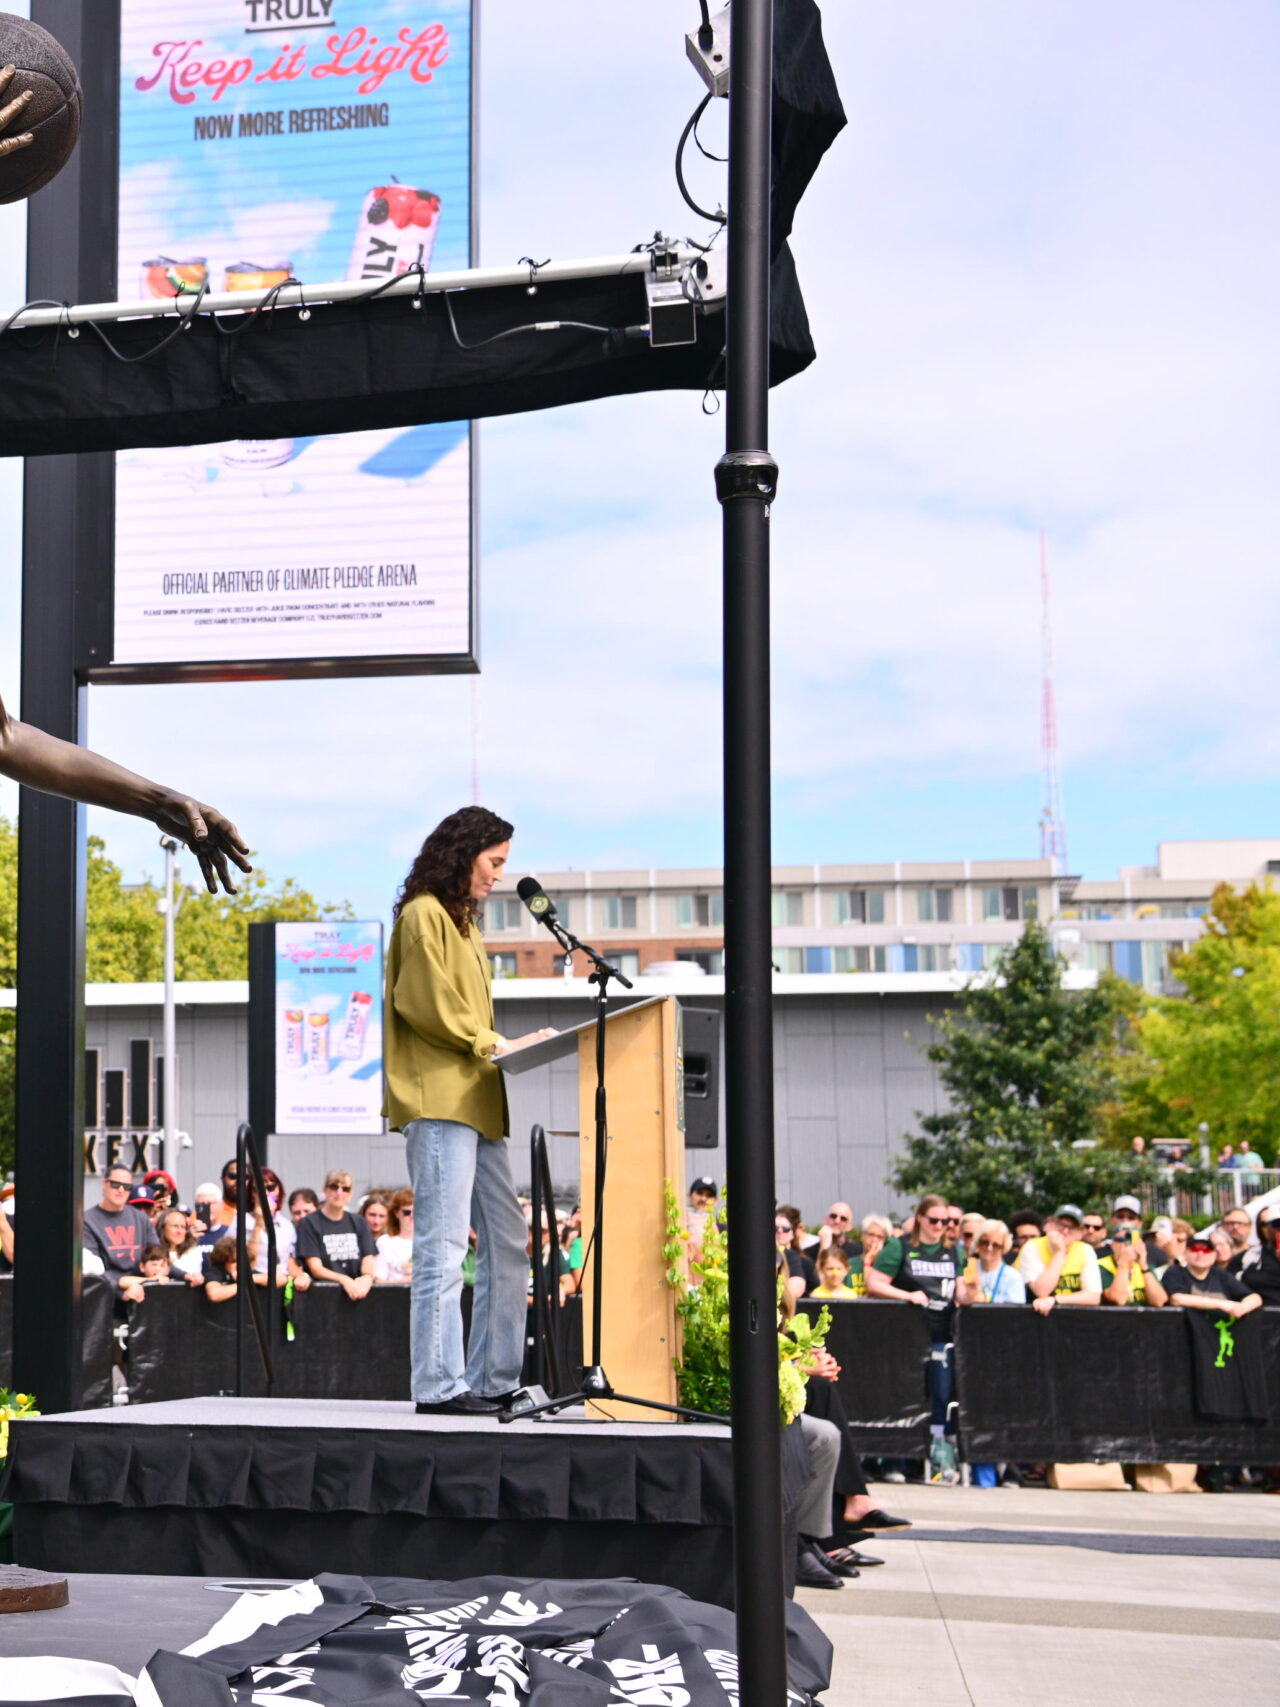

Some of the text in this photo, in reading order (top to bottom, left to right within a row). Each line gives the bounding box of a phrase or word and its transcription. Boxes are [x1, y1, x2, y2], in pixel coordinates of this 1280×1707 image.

[245, 0, 334, 22] TRULY
[134, 24, 449, 105] Keep it Light
[194, 103, 389, 141] NOW MORE REFRESHING
[163, 564, 418, 595] OFFICIAL PARTNER OF CLIMATE PLEDGE ARENA
[85, 1134, 164, 1173] KEX
